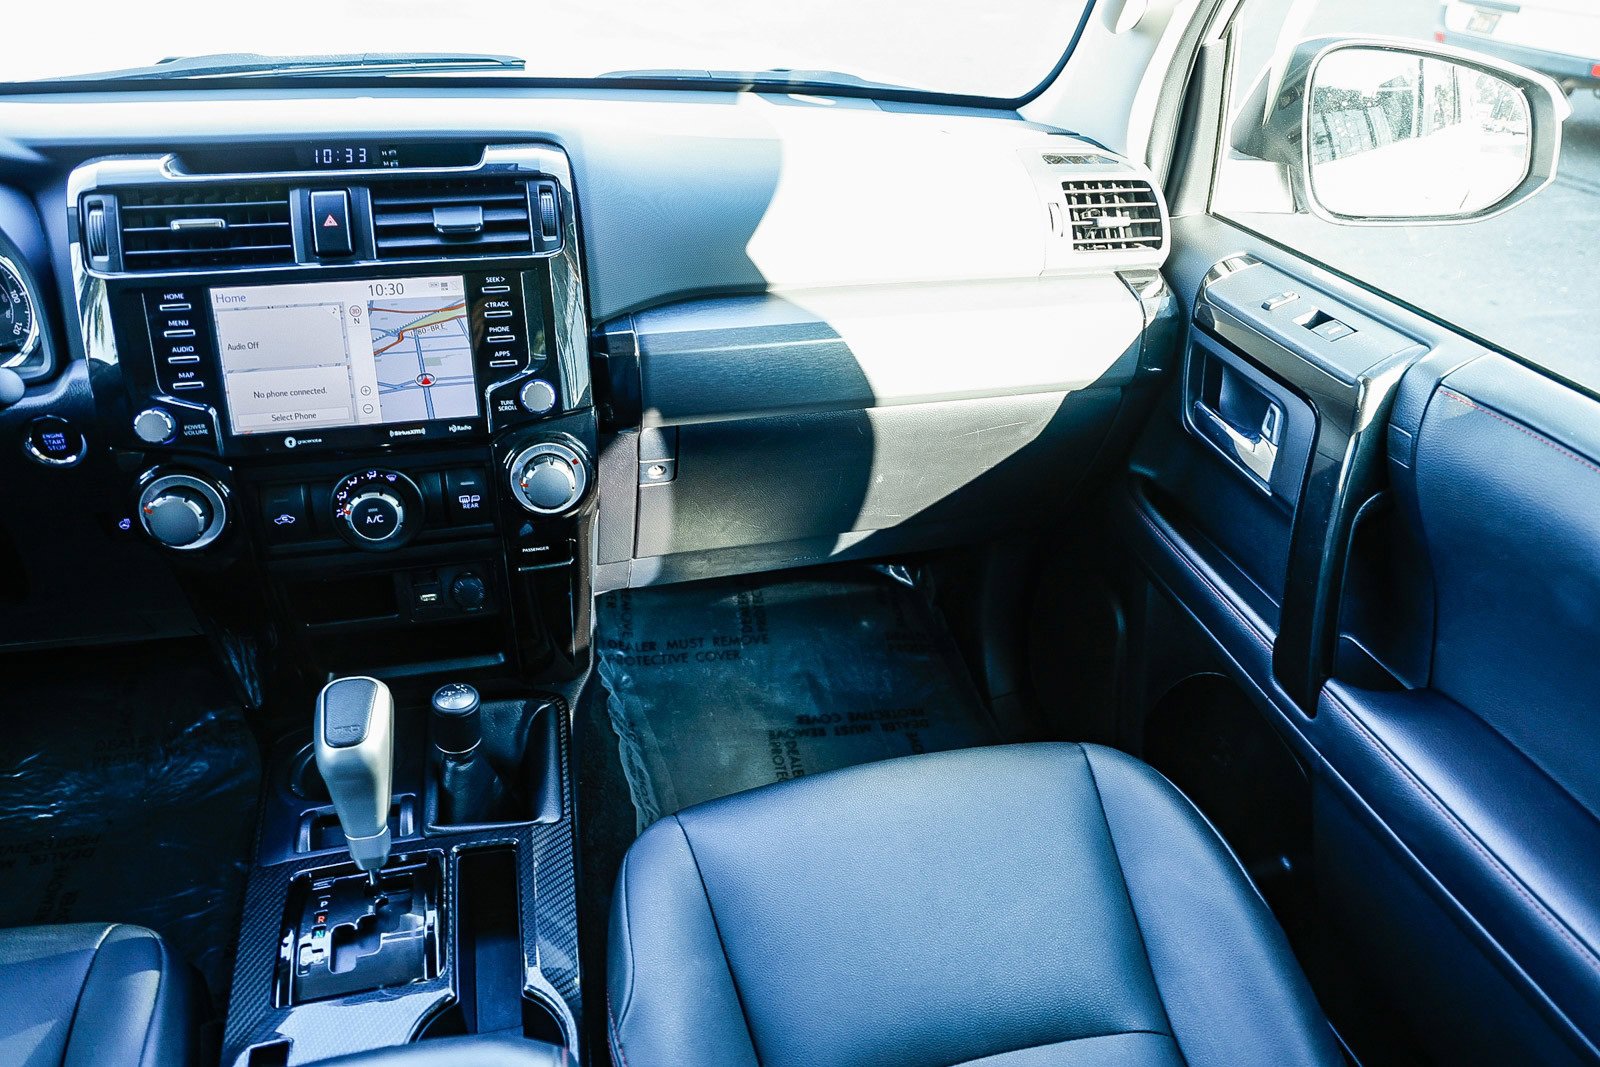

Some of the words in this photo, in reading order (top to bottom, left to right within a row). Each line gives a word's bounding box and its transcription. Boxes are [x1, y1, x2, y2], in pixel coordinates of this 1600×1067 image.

[315, 148, 367, 164] 10:33
[368, 282, 405, 297] 10:30
[215, 293, 247, 304] Home
[167, 319, 190, 327] MENU
[171, 345, 195, 353] AUDIO
[227, 342, 245, 351] Audio
[246, 341, 259, 350] Off
[178, 371, 195, 379] MAP
[253, 391, 265, 399] No
[266, 390, 288, 401] phone
[289, 387, 328, 398] connected.
[271, 413, 293, 422] Select
[294, 411, 317, 421] Phone
[366, 515, 384, 524] A/C
[667, 637, 704, 650] MUST
[713, 633, 769, 647] REMOVE
[696, 650, 740, 663] COVER
[320, 900, 329, 908] P
[317, 915, 325, 923] R
[315, 930, 324, 938] N
